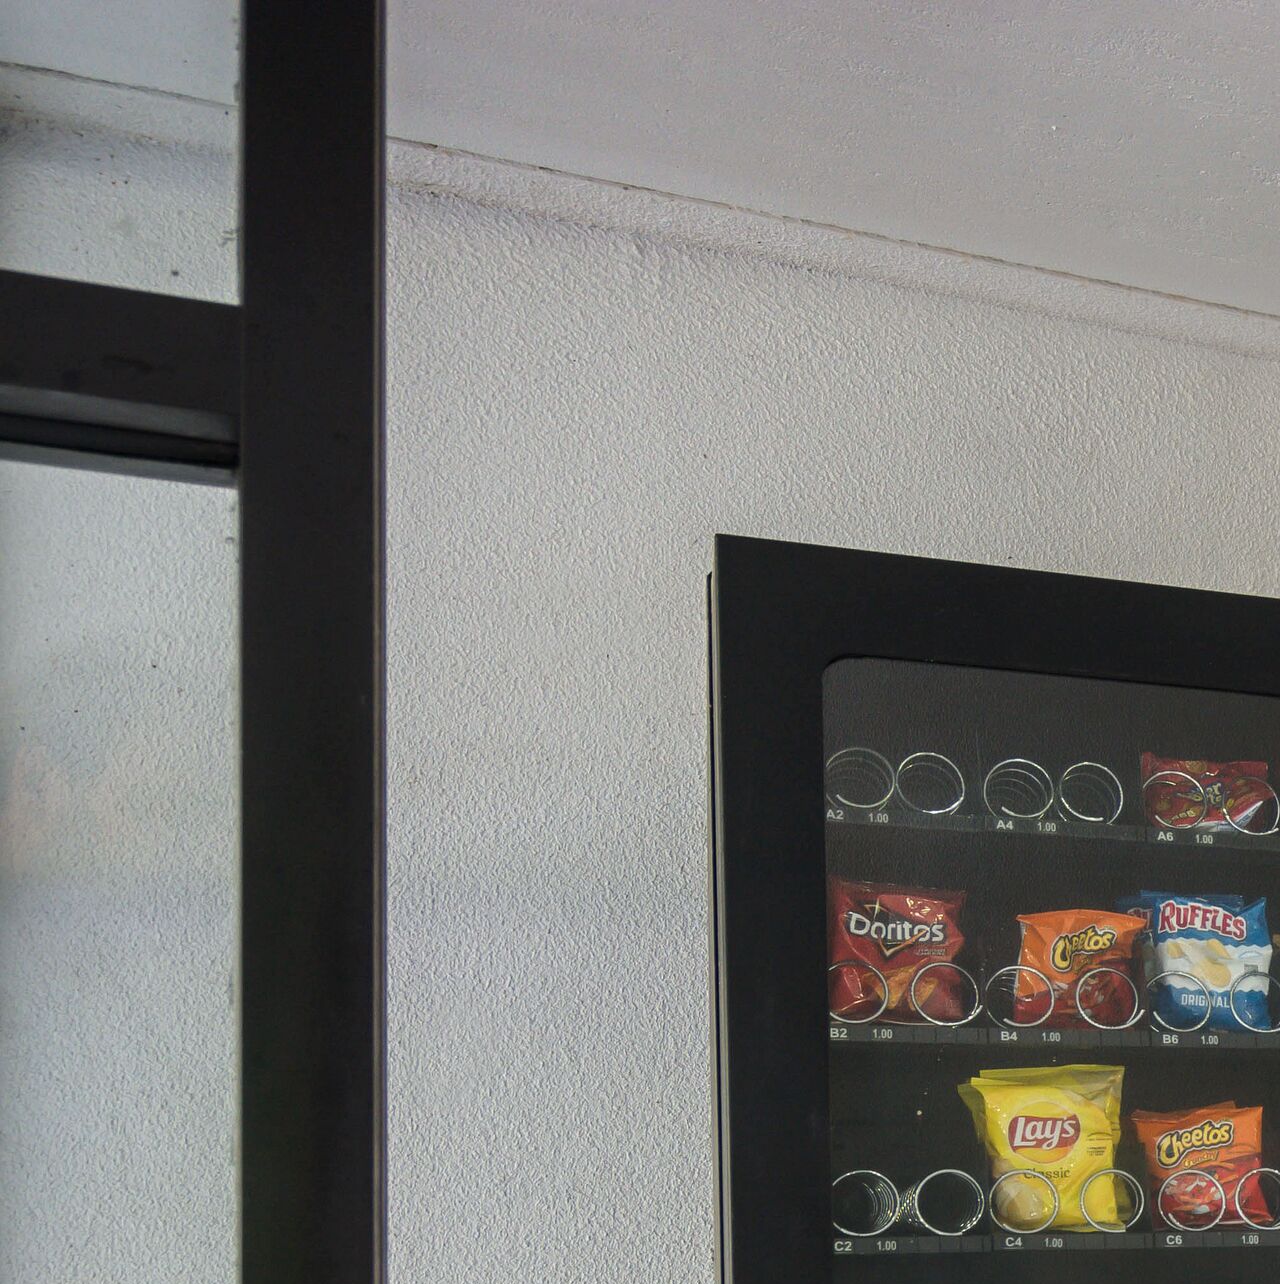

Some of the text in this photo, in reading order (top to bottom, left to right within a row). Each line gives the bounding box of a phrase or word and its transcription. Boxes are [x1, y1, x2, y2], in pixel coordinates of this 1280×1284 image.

[826, 809, 889, 823] A2 1.00
[997, 820, 1056, 832] A4 1.00
[1157, 832, 1214, 844] A6 1.00
[849, 911, 945, 942] Doritos
[1158, 900, 1247, 941] RUFFLES
[829, 1028, 893, 1039] B2 1.00
[1001, 1032, 1061, 1042] B4 1.00
[1162, 1034, 1219, 1045] B6 1.00
[1013, 1116, 1077, 1150] Lay's
[1157, 1121, 1233, 1167] Cheetos
[1005, 1237, 1063, 1248] C4 1.00
[1166, 1234, 1260, 1245] C6 1.00
[834, 1240, 897, 1252] C2 1.00
